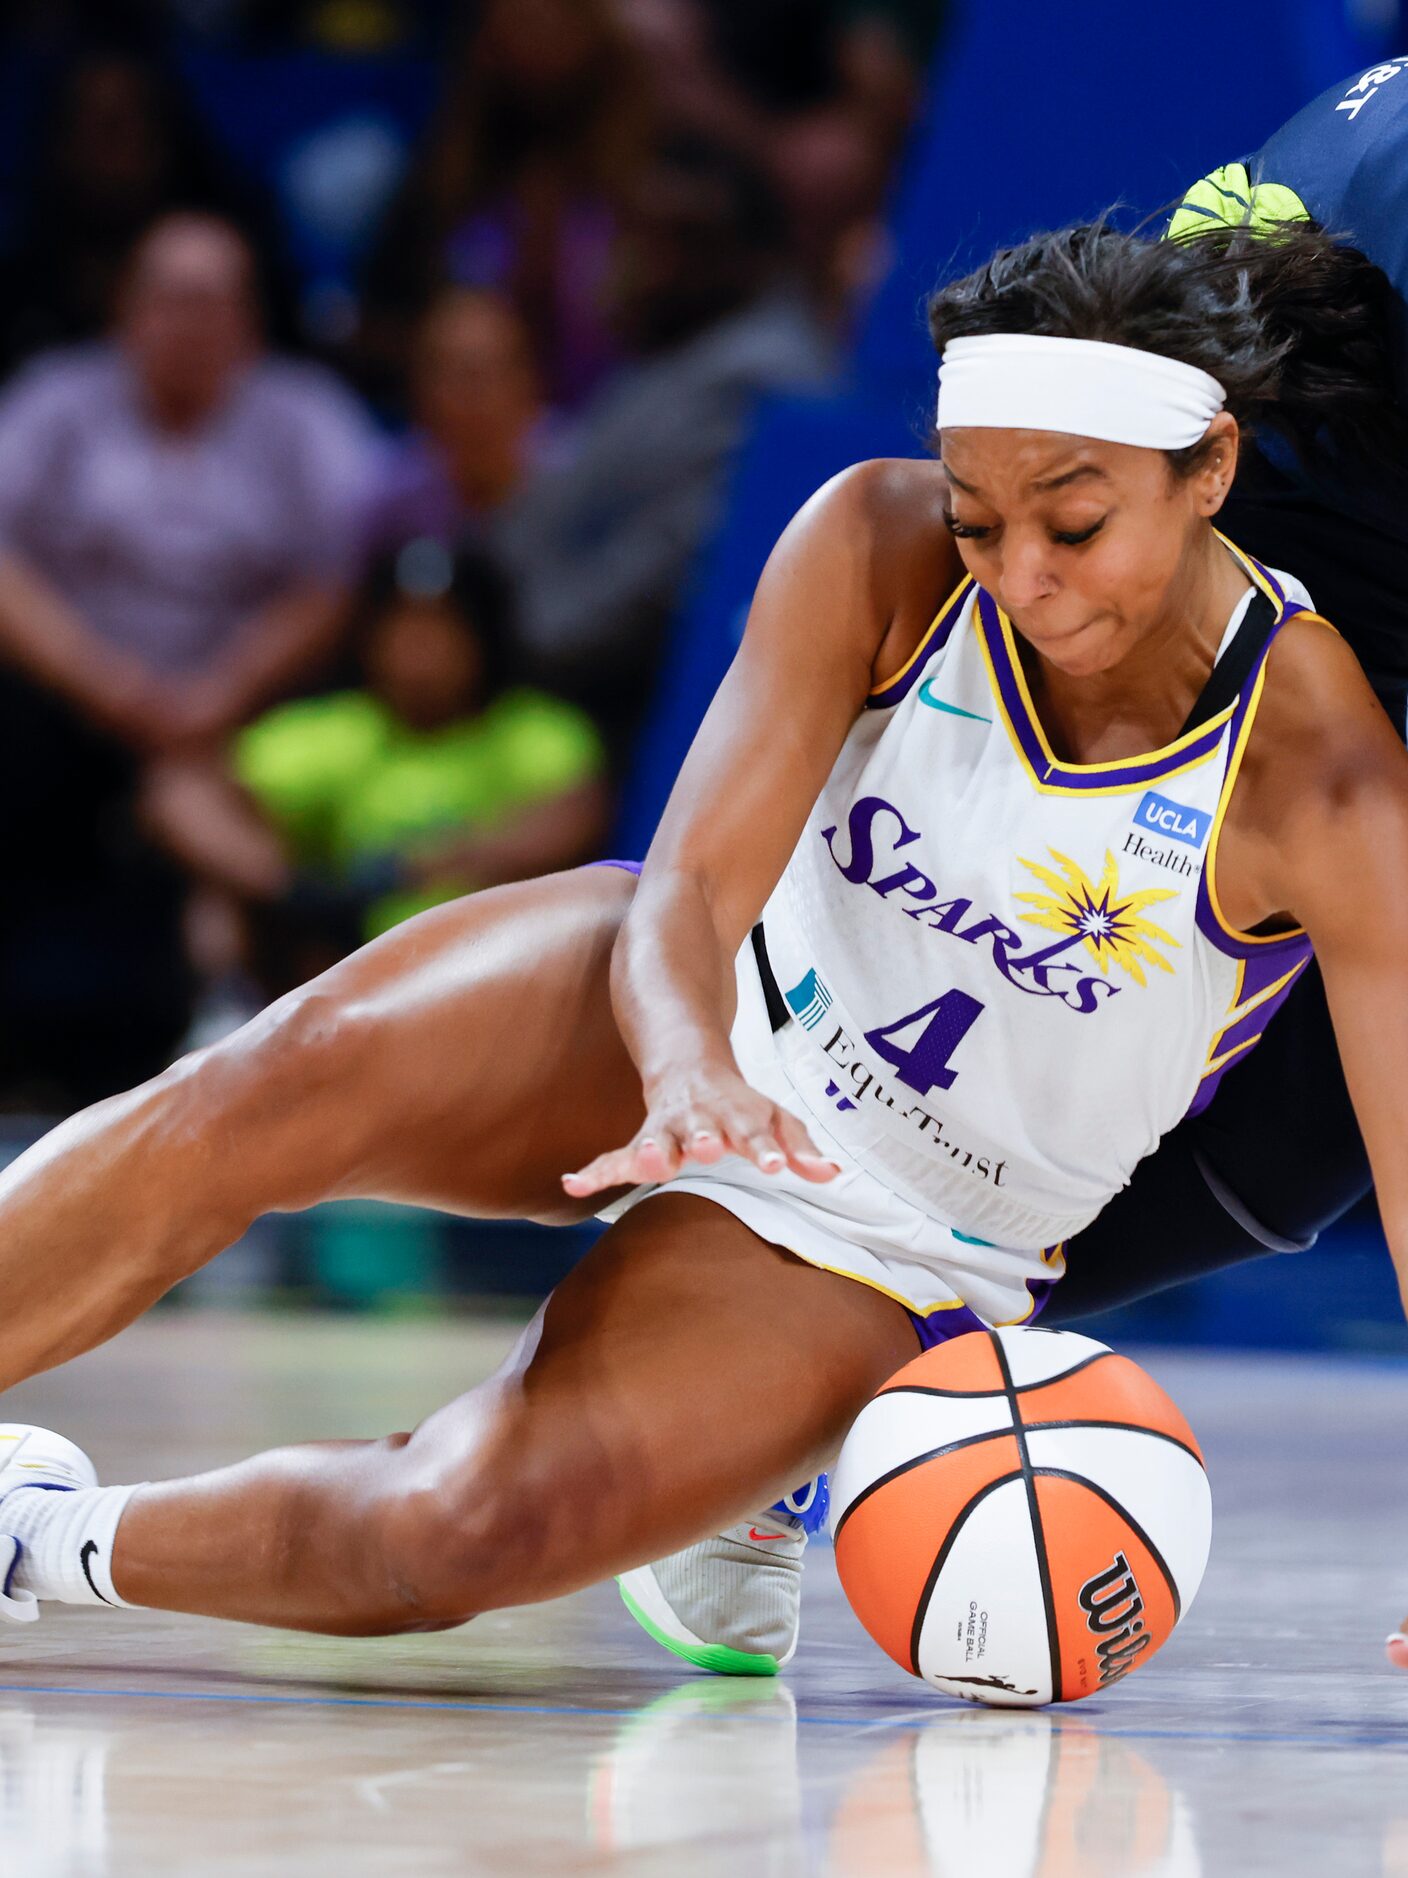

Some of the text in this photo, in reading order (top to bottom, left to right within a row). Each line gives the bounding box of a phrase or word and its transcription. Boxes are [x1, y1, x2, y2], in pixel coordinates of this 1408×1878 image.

[1145, 802, 1197, 839] UCLA
[864, 988, 985, 1097] 4
[820, 1025, 1009, 1188] EquTust
[965, 1601, 978, 1663] GAME BALL
[977, 1611, 989, 1659] OFFICIAL
